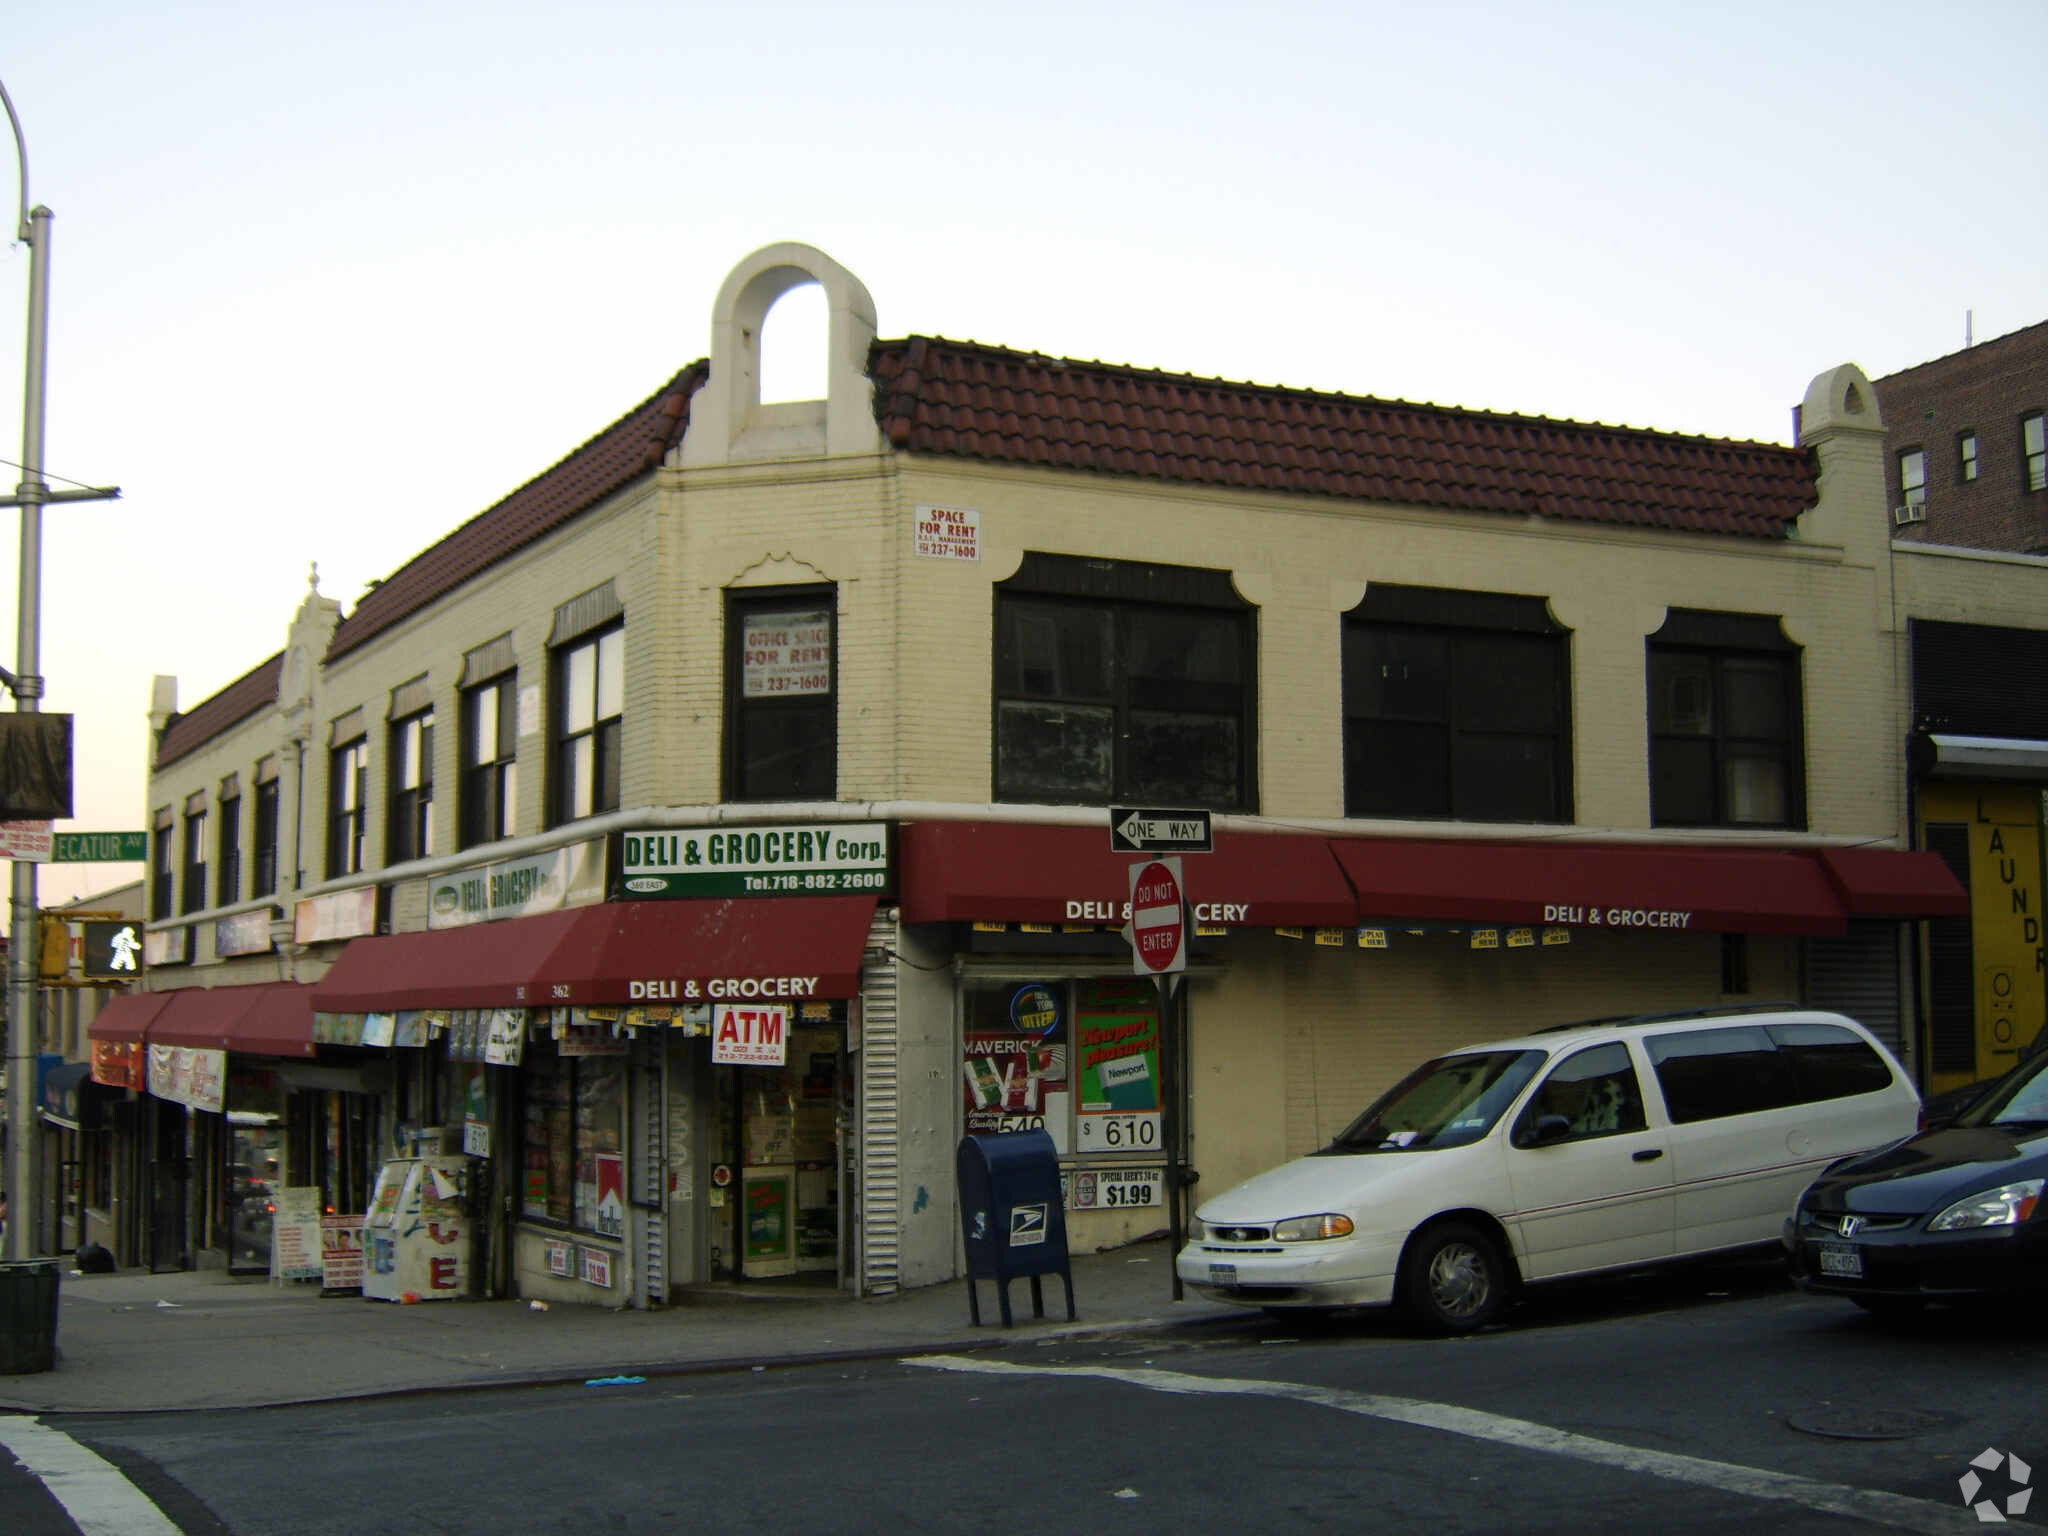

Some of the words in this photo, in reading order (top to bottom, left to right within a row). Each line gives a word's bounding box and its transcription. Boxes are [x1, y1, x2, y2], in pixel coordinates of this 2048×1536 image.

[931, 509, 965, 524] SPACE
[919, 522, 941, 535] FOR
[947, 525, 977, 538] RENT
[931, 543, 976, 558] 237-1600
[744, 650, 779, 666] FOR
[767, 675, 828, 691] 237-1600
[1127, 822, 1156, 838] ONE
[1168, 822, 1198, 838] WAY
[57, 835, 121, 860] ECATUR
[625, 836, 677, 867] DELI
[684, 839, 701, 865] &
[707, 830, 831, 865] GROCERY
[835, 838, 886, 862] Corp.
[1138, 886, 1151, 904] DO
[1153, 882, 1173, 902] NOT
[1066, 901, 1113, 920] DELI
[1121, 902, 1132, 920] &
[1194, 904, 1249, 922] CERY
[1544, 905, 1583, 924] DELI
[1588, 908, 1601, 925] &
[1605, 909, 1691, 929] GROCERY
[1143, 931, 1174, 952] ENTER
[629, 981, 677, 1000] DELI
[684, 981, 701, 998] &
[707, 977, 819, 998] GROCERY
[718, 1011, 782, 1045] ATM
[1108, 1063, 1146, 1081] Newport
[1083, 1122, 1091, 1136] $
[1100, 1172, 1123, 1183] SPECIAL
[1107, 1184, 1152, 1206] $1.99
